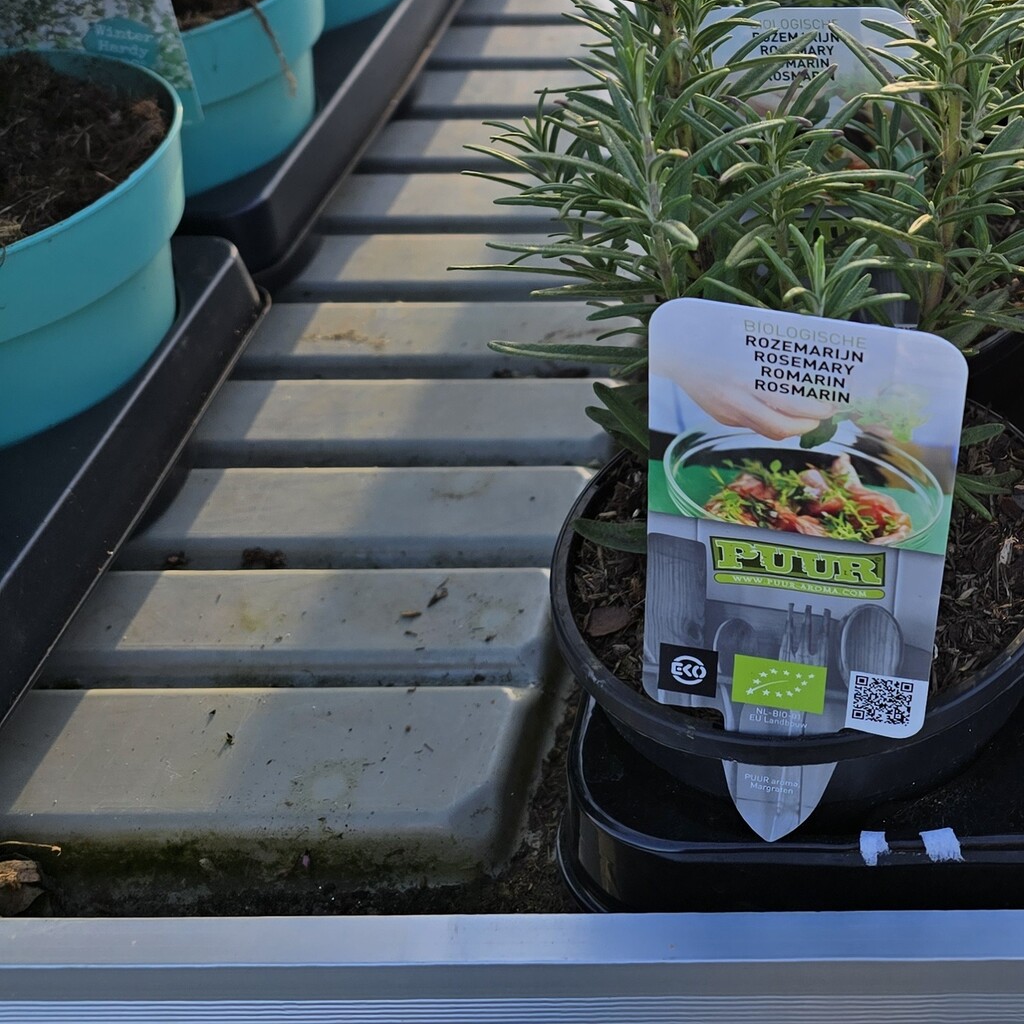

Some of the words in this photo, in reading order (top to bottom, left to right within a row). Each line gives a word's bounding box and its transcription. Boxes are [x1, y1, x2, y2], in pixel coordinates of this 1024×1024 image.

[744, 319, 867, 350] BIOLOGISCHE
[745, 335, 864, 363] ROZEMARIJN
[754, 350, 855, 376] ROSEMARY
[761, 365, 846, 389] ROMARIN
[754, 379, 850, 404] ROSMARIN
[714, 539, 882, 585] PUUR
[671, 659, 707, 681] EKO
[749, 714, 762, 722] EU
[744, 773, 770, 784] PUUR
